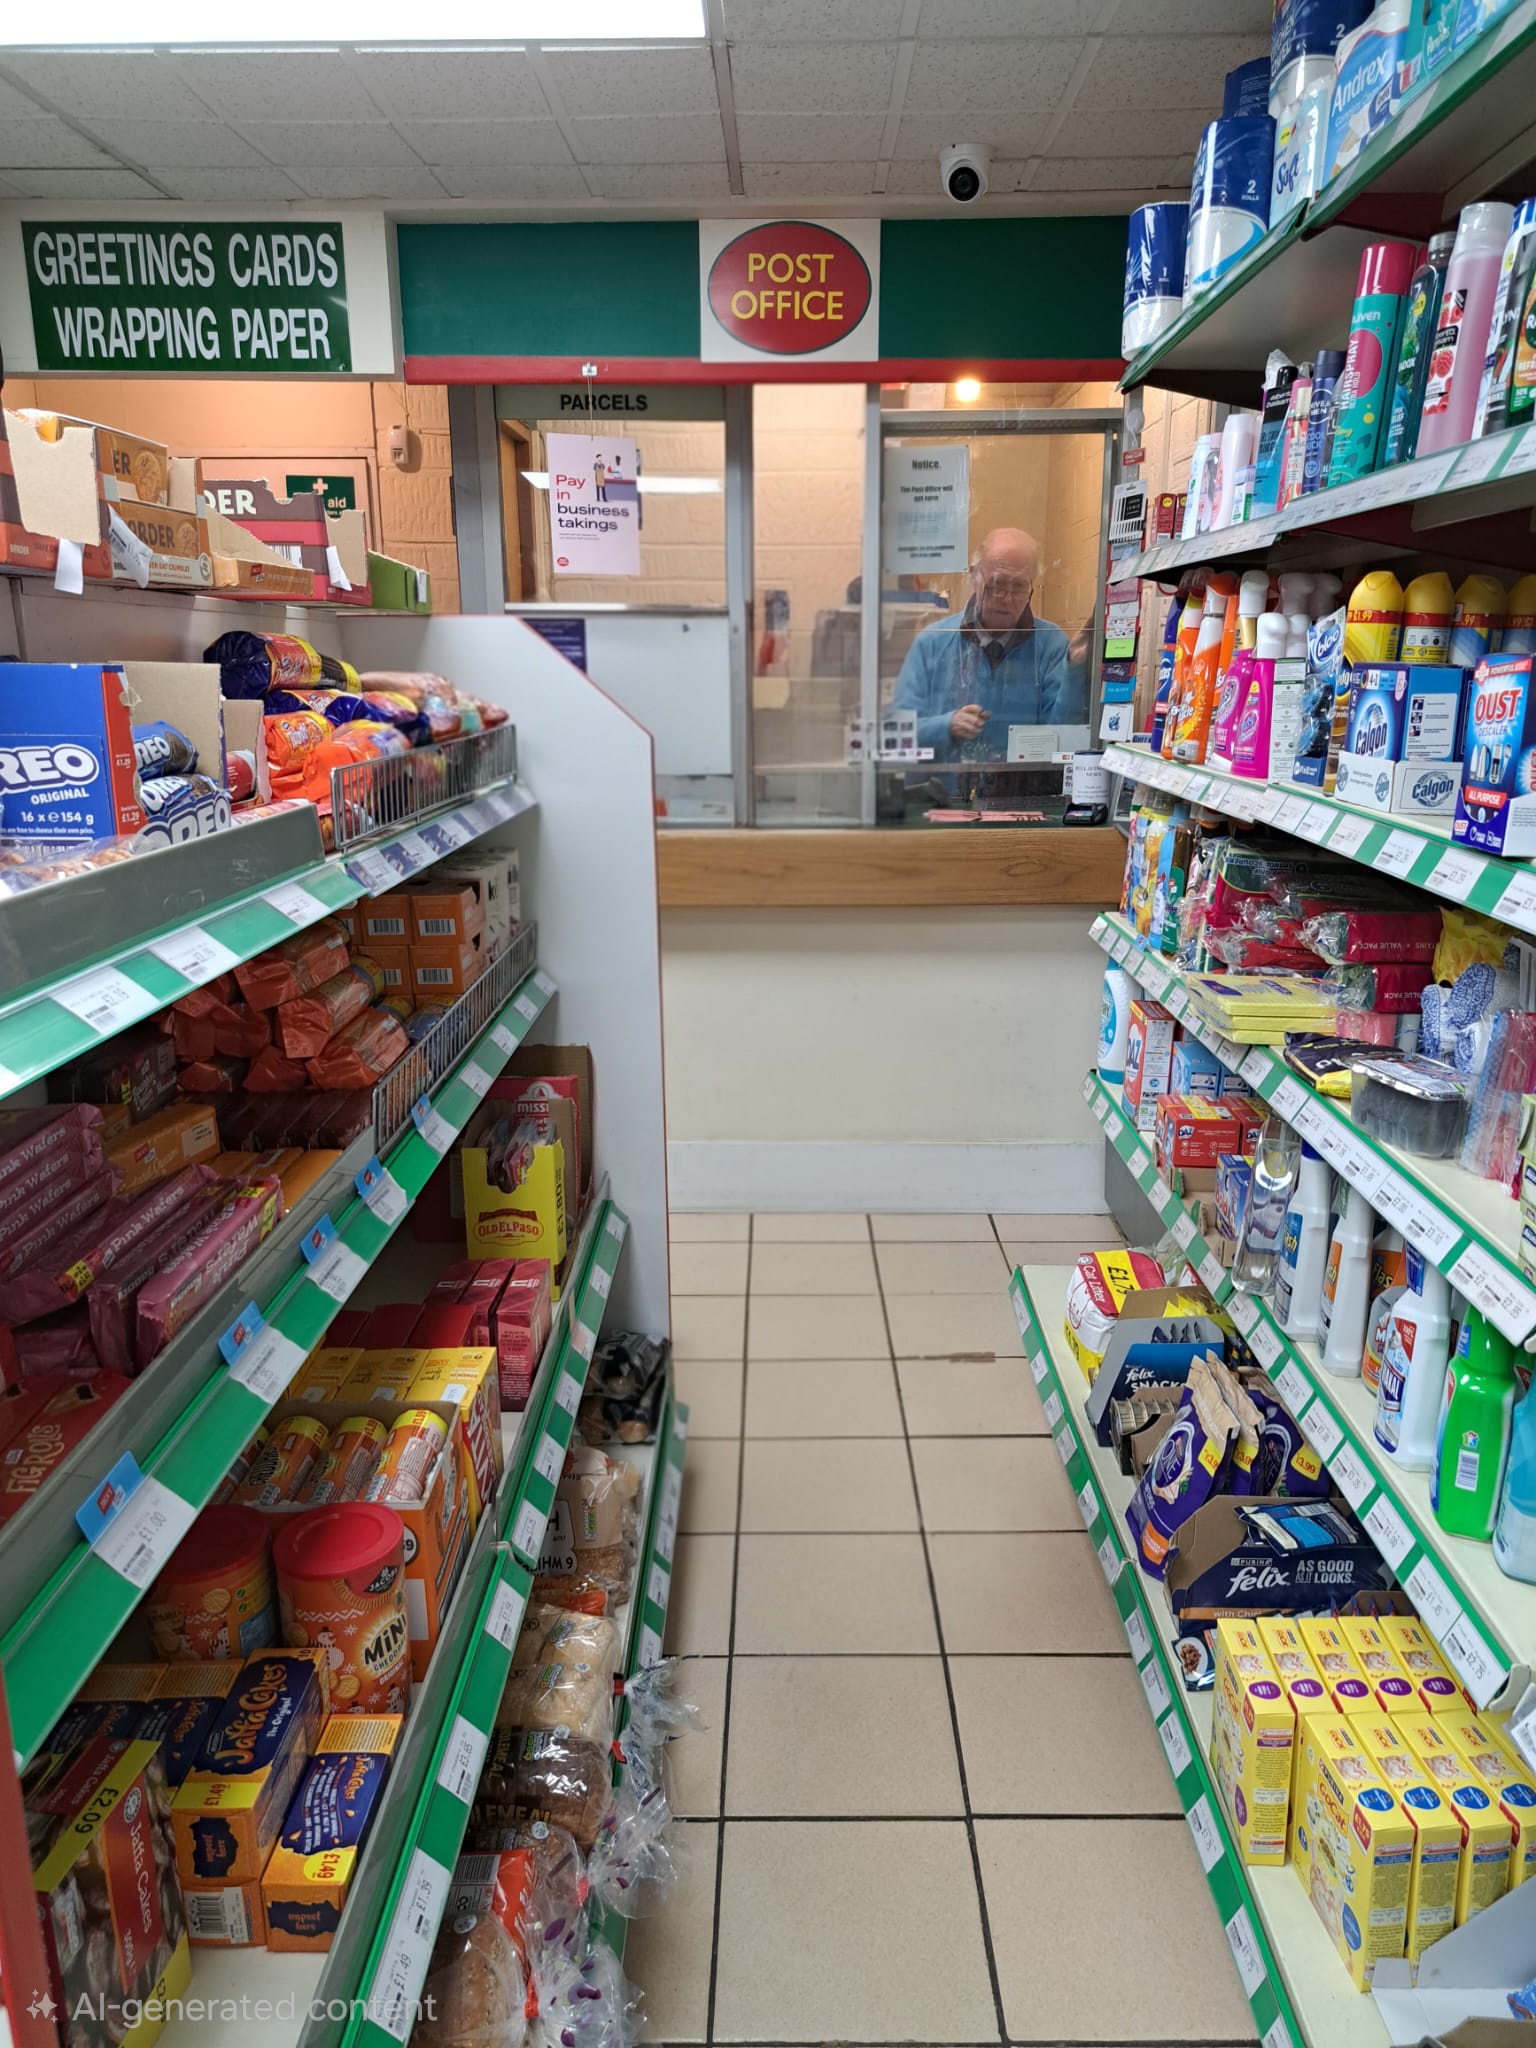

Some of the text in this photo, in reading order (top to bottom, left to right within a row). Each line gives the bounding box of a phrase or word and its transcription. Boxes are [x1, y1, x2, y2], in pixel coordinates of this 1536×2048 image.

[1336, 24, 1345, 38] 2
[1332, 50, 1387, 117] Andrex
[1248, 180, 1256, 193] 2
[33, 232, 338, 287] GREETINGS CARDS
[749, 253, 834, 283] POST
[1162, 267, 1167, 277] 1
[731, 290, 843, 320] OFFICE
[53, 307, 331, 360] WRAPPING PAPER
[1340, 340, 1359, 410] HAIRSPRAY
[560, 394, 647, 411] PARCELS
[556, 474, 586, 489] Pay
[557, 489, 570, 500] in
[557, 503, 629, 517] business
[558, 517, 618, 532] takings
[1475, 688, 1521, 724] OUST
[1356, 722, 1388, 756] Calgon
[1478, 726, 1508, 737] DESCALER
[31, 787, 90, 805] ORIGINAL
[140, 776, 189, 812] OREO
[1412, 778, 1455, 800] Calgon
[1478, 791, 1501, 805] PURPOSE
[21, 811, 34, 823] 16
[61, 811, 82, 823] 154
[86, 813, 95, 825] g
[121, 813, 140, 823] £1.29
[21, 1127, 66, 1160] Wafers
[1178, 1127, 1195, 1138] DAZ
[26, 1153, 70, 1188] Wafers
[29, 1179, 72, 1214] Wafers
[111, 1186, 185, 1252] Pink Wafers
[479, 1220, 498, 1237] OLD
[499, 1220, 512, 1234] EL
[1083, 1265, 1096, 1282] Cat
[1126, 1368, 1156, 1385] felix
[6, 1423, 65, 1494] FIG ROLLS
[1161, 1439, 1182, 1483] ONE
[139, 1511, 168, 1542] £1.00
[1296, 1560, 1354, 1572] AS GOOD
[1225, 1566, 1290, 1599] felix
[1213, 1609, 1235, 1618] with
[214, 1663, 288, 1765] Jaffa Cakes
[272, 1697, 292, 1726] Original
[204, 1782, 230, 1807] £1.49
[1319, 1784, 1347, 1830] GoCat
[75, 1786, 119, 1835] £2.09
[130, 1822, 153, 1934] Jaffa Cakes
[316, 1853, 341, 1879] £1.49
[416, 1878, 433, 1914] £1.39
[394, 1953, 413, 1992] £1.49
